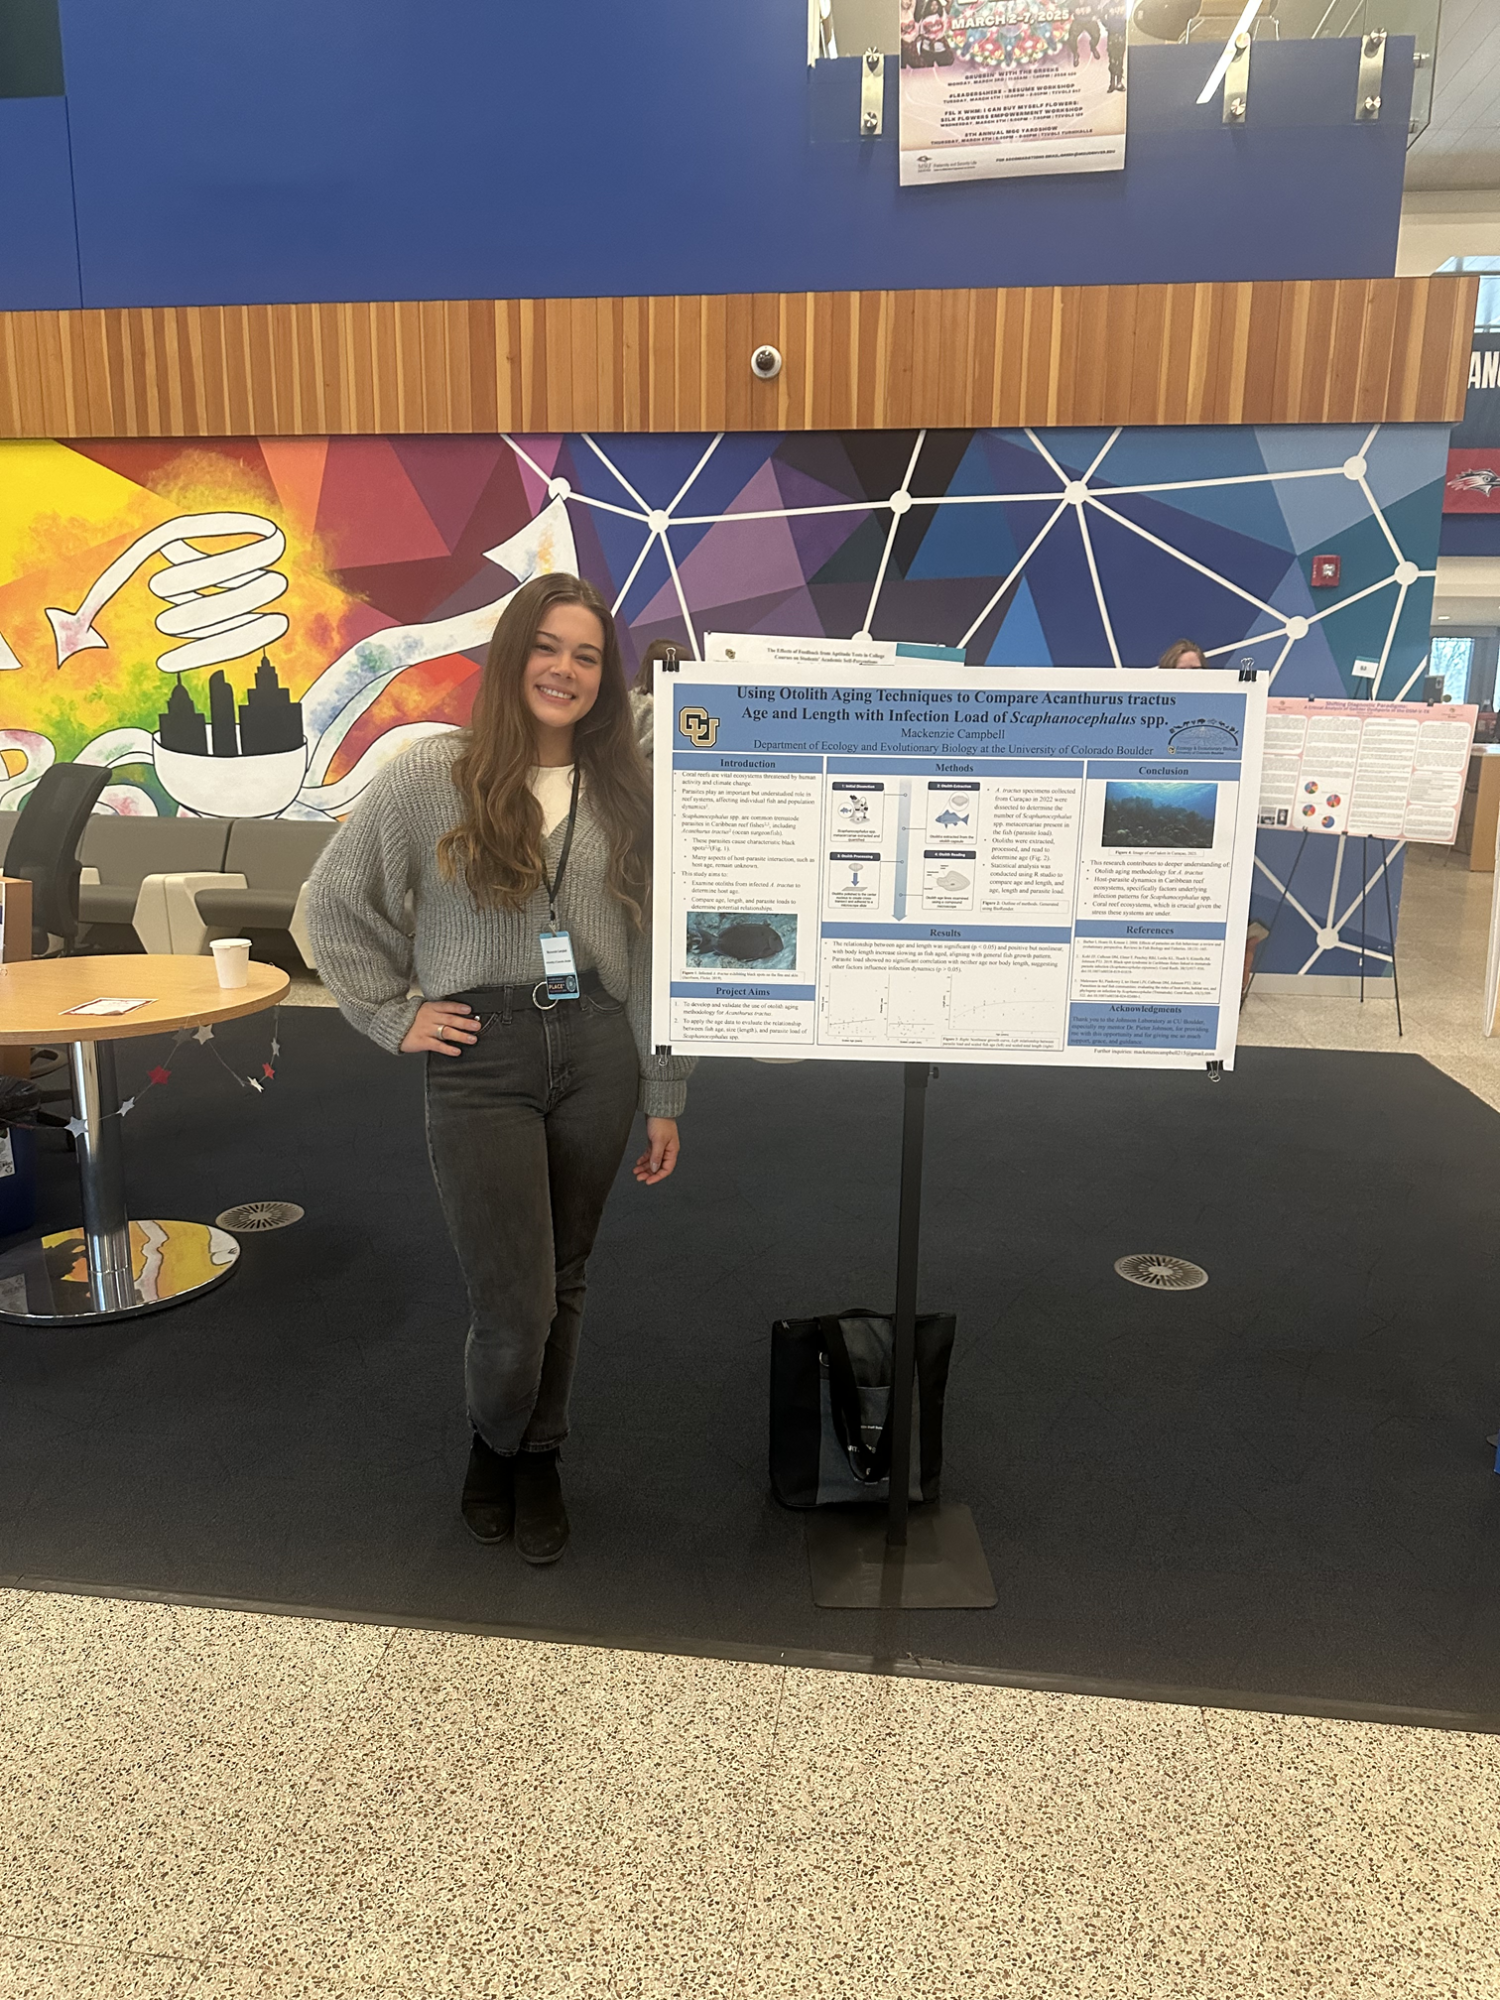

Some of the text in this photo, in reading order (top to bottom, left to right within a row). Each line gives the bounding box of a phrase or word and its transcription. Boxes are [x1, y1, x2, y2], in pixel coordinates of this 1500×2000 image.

[952, 16, 1006, 30] MARCH
[1008, 14, 1035, 26] 2-7,
[1037, 11, 1069, 23] 2025
[990, 110, 1043, 118] EMPOWERMENT
[1045, 106, 1083, 114] WORKSHOP
[737, 686, 1176, 706] Using Otolith Aging Techniques to Compare Acanthurus tractus
[742, 706, 1169, 728] Age and Length with Infection Load of Scaphanocephalus spp.
[679, 706, 719, 747] CU
[901, 727, 1005, 741] Mackenzie Campbell
[753, 739, 1154, 756] Department of Ecology and Evolutionary Biology at the University of Colorado Boulder
[720, 759, 776, 769] Introduction
[935, 763, 974, 773] Methods
[1138, 766, 1189, 775] Conclusion
[930, 928, 961, 937] Results
[1126, 926, 1174, 935] References
[716, 986, 770, 996] Project Aims
[1109, 1004, 1182, 1014] Acknowledgments
